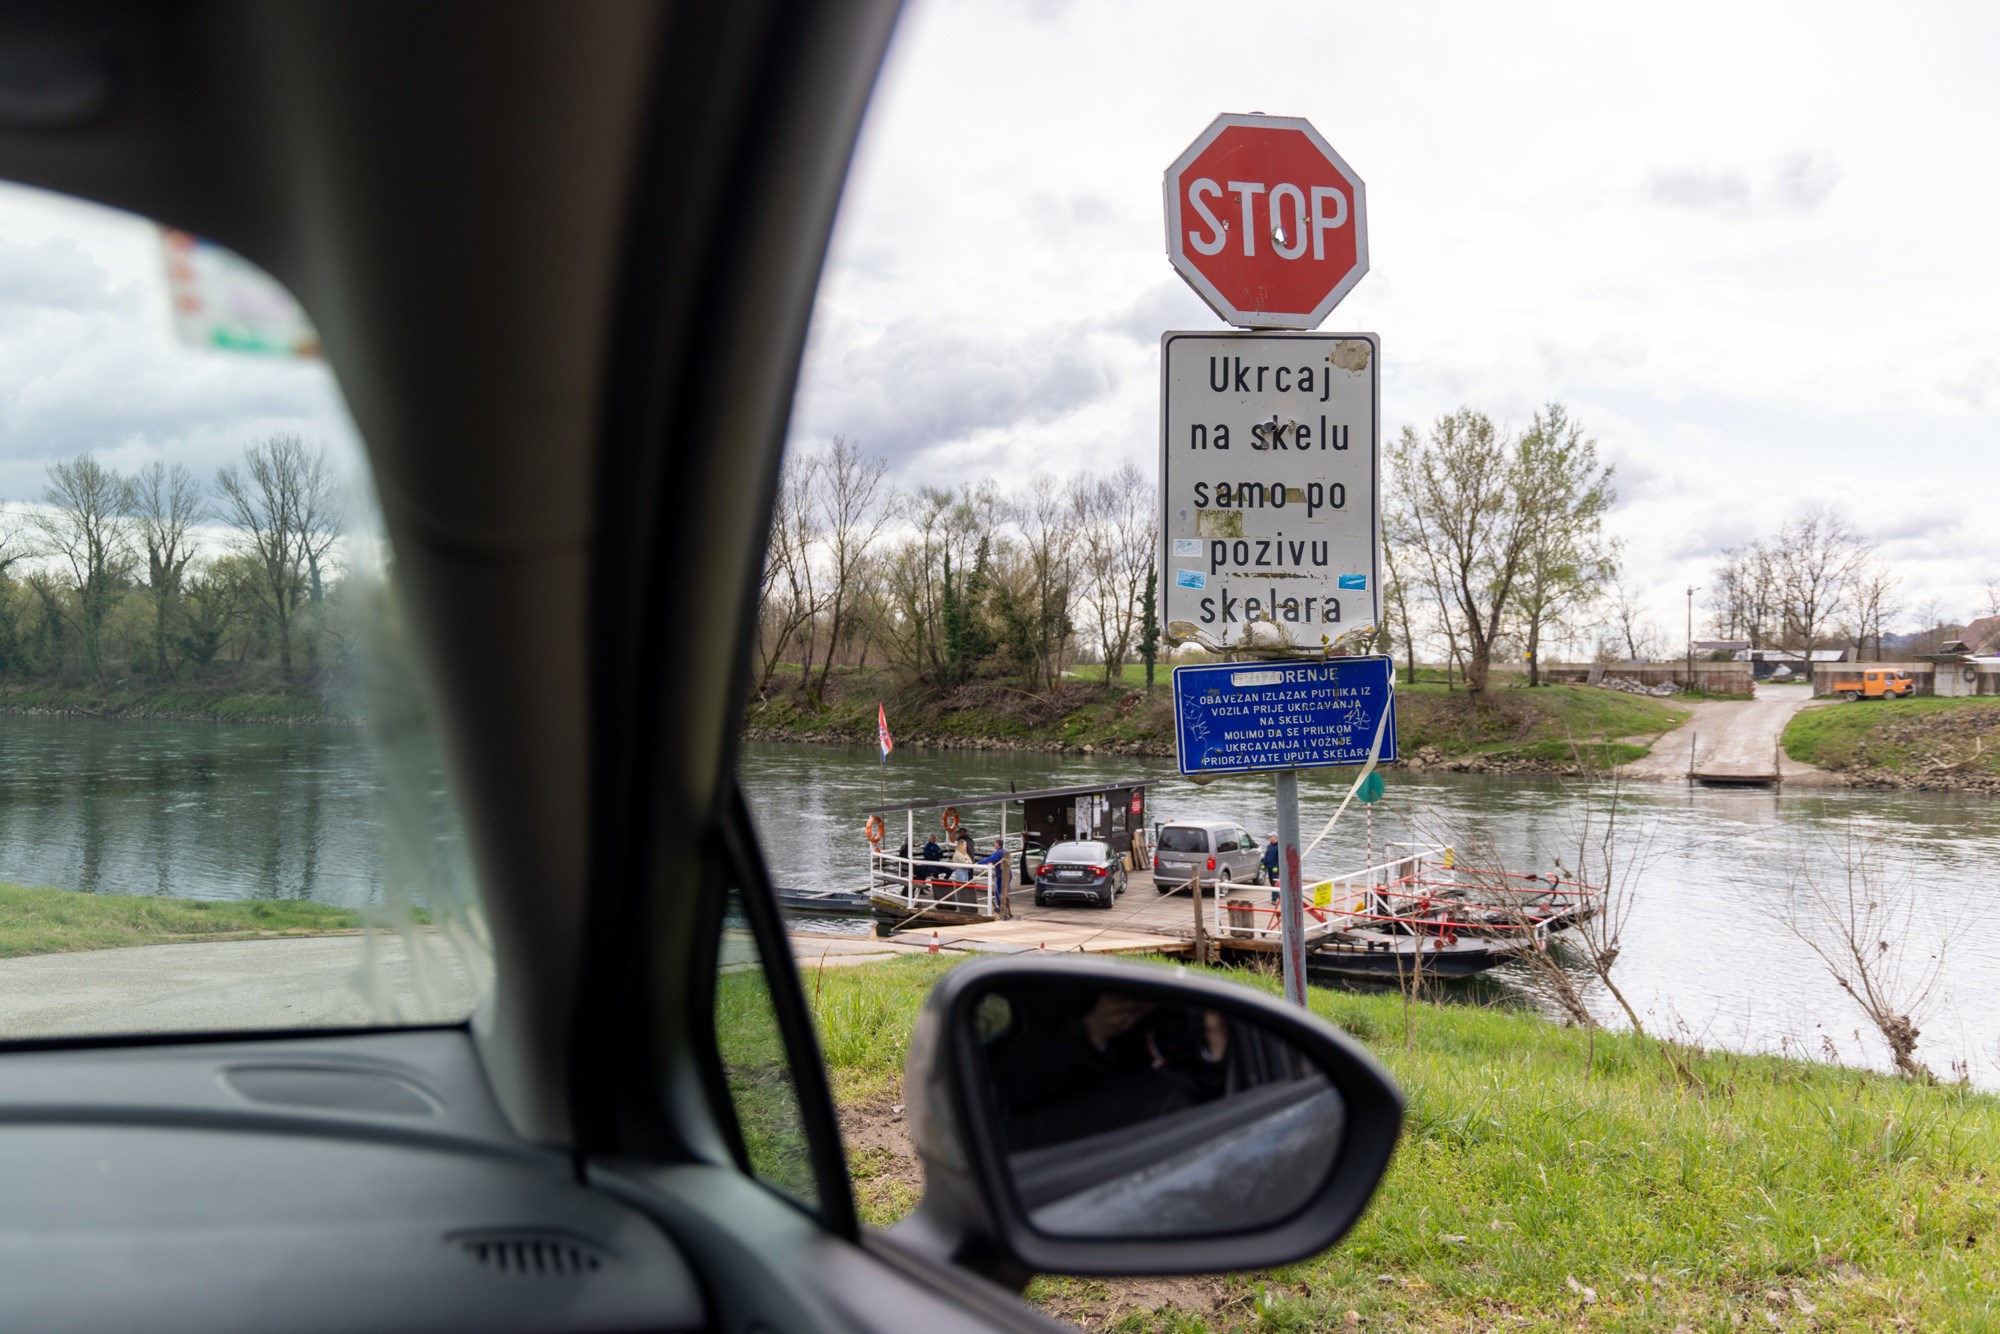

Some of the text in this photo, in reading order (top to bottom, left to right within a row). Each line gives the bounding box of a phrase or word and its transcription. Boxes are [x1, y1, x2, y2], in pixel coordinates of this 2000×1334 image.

[1188, 177, 1348, 261] STOP
[1209, 356, 1330, 402] Ukrcaj
[1191, 414, 1349, 451] na skelu
[1193, 481, 1346, 518] samo po
[1210, 532, 1329, 575] pozivu
[1199, 588, 1341, 623] skelara
[1200, 686, 1371, 705] OBAVEZAN IZLAZAK PUTNIKA IZ
[1211, 699, 1362, 717] VOZILA PRIJE UKRCAVANJA
[1224, 724, 1352, 740] MOLIMO DA SE PRILIKOM
[1260, 714, 1315, 726] NA SKELU.
[1225, 735, 1352, 752] UKRCAVANJA I VOŽNJE
[1283, 750, 1319, 761] UPUTA
[1322, 748, 1371, 759] SKELARA
